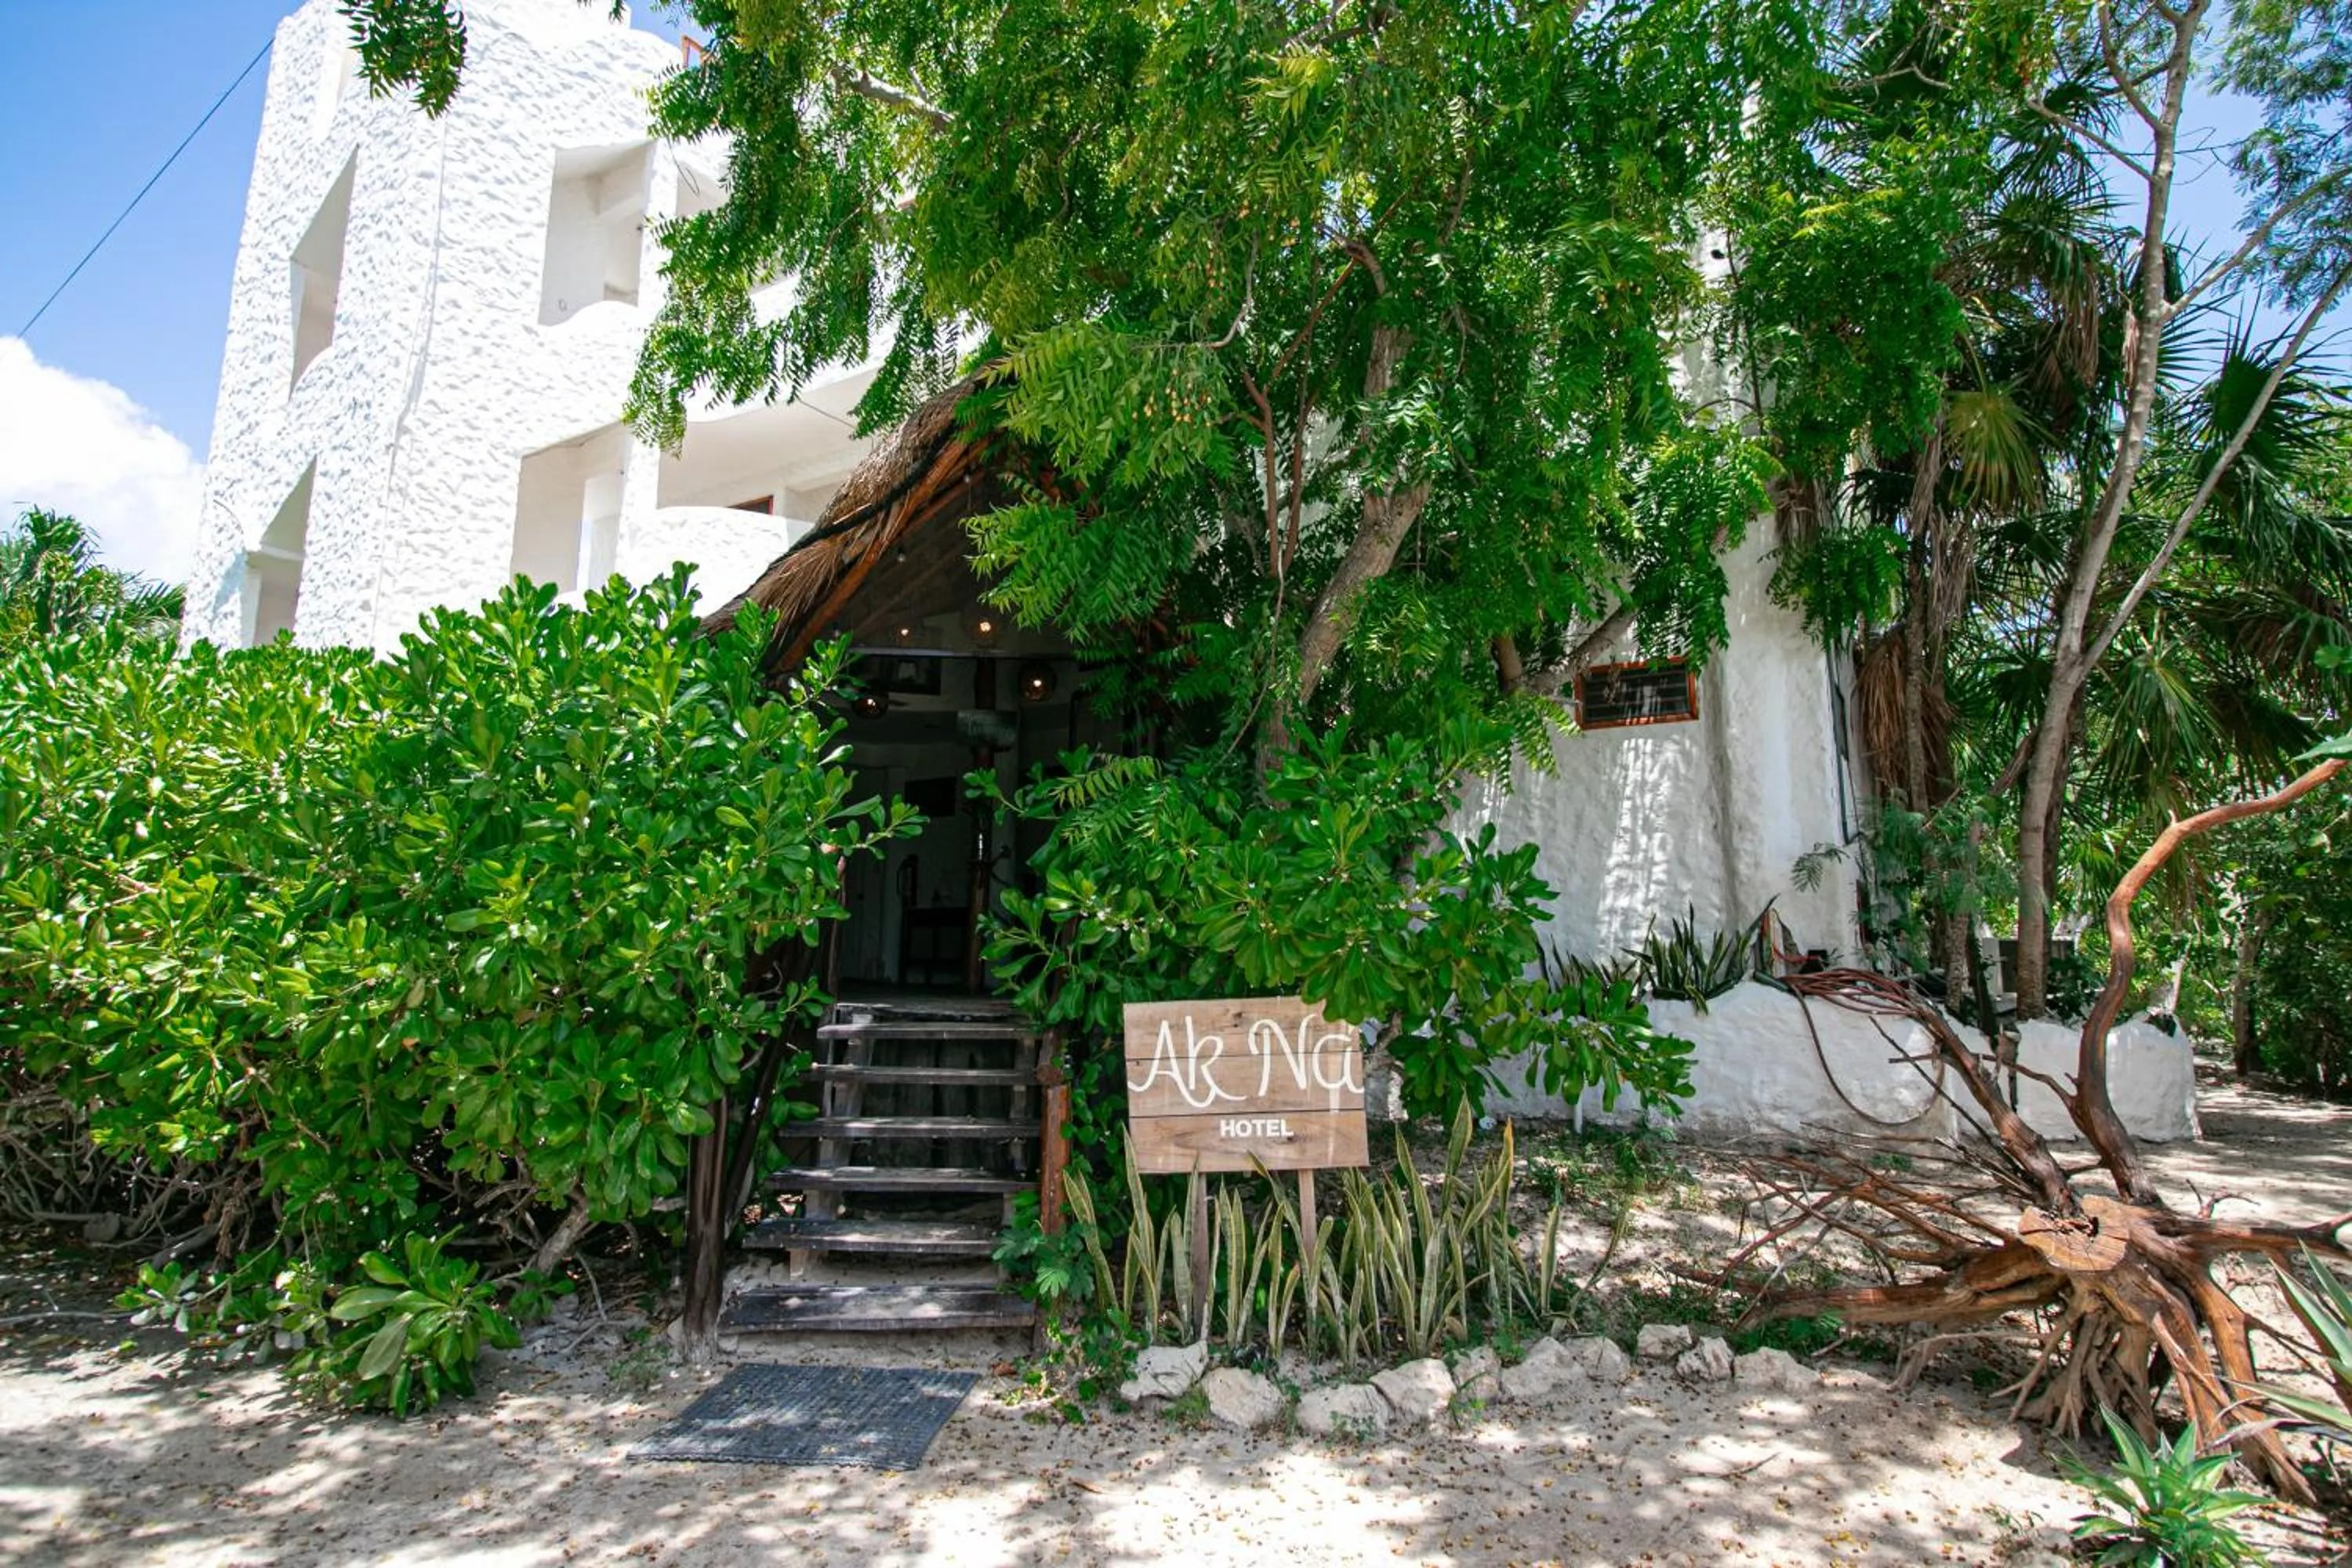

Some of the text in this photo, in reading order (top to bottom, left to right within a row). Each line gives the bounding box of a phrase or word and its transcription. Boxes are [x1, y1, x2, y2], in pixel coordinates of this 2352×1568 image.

[1127, 1014, 1364, 1108] Ak Na
[1220, 1119, 1294, 1138] HOTEL
